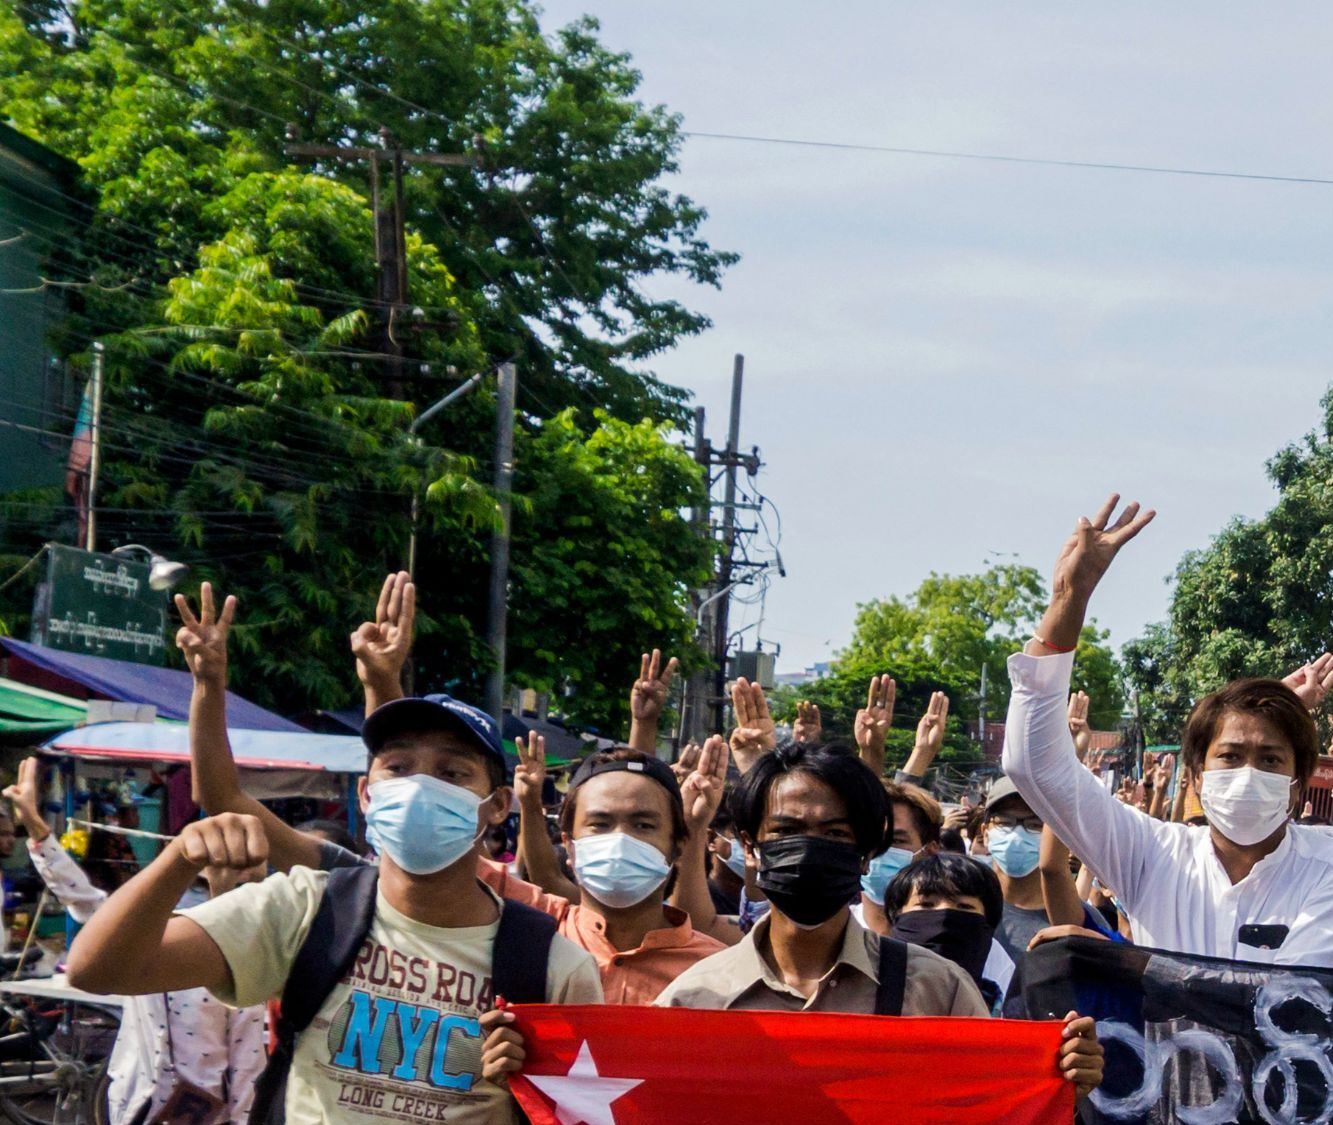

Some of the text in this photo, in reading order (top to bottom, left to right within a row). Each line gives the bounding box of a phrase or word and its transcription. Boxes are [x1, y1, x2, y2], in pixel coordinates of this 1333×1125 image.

[341, 940, 429, 993] ROSS
[334, 989, 482, 1092] NYC
[338, 1084, 384, 1109] LONG
[392, 1095, 449, 1121] CREEK
